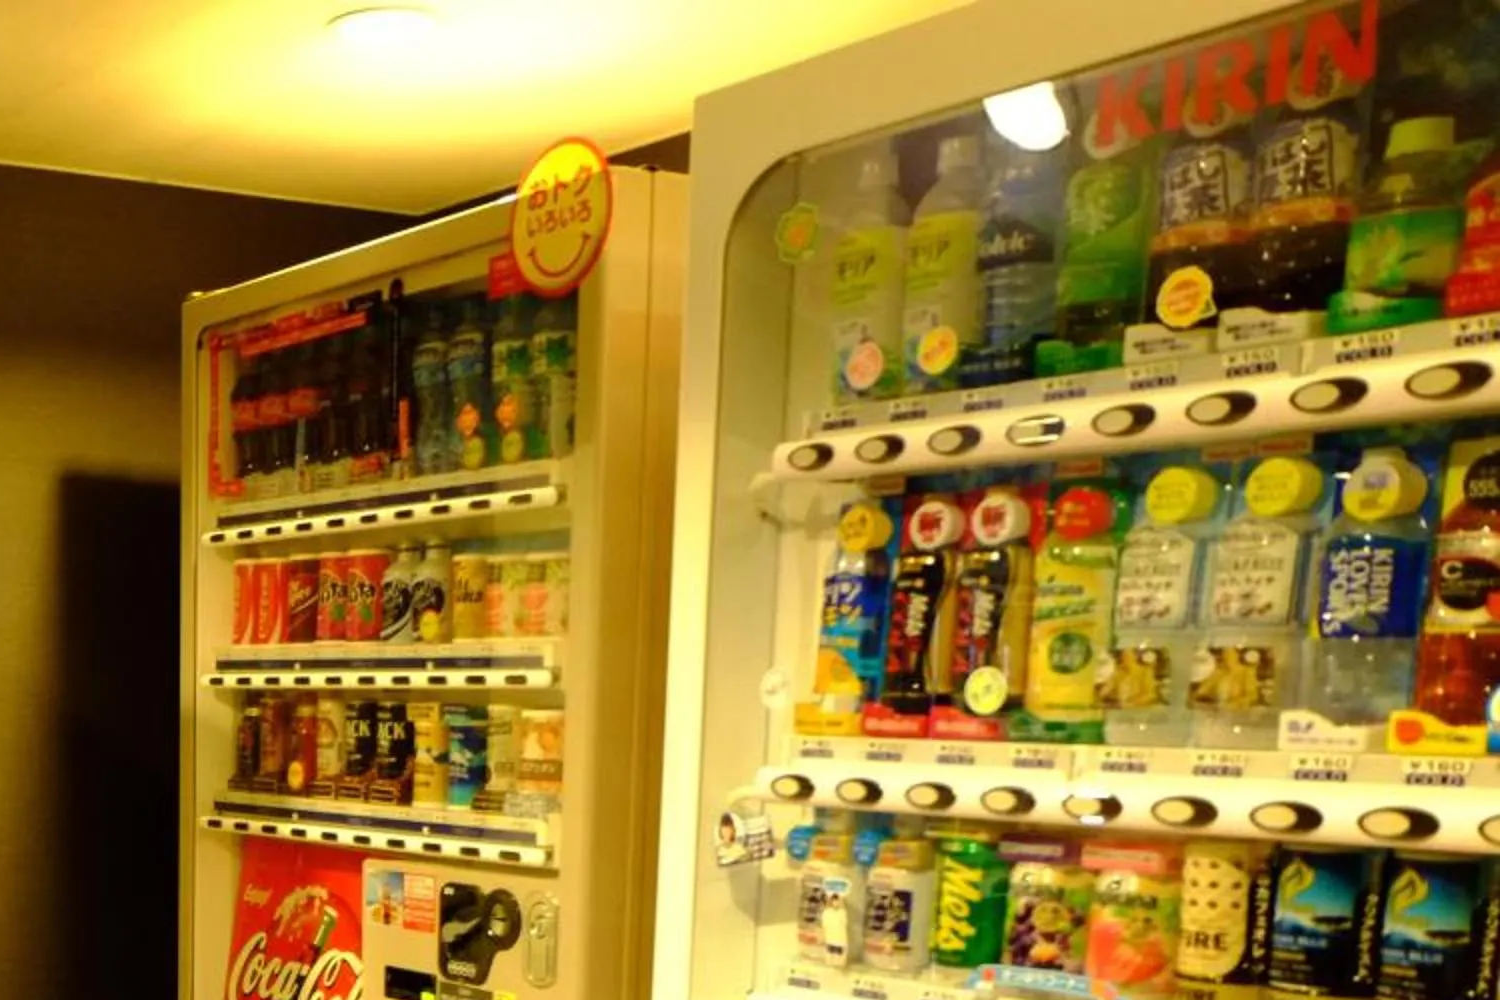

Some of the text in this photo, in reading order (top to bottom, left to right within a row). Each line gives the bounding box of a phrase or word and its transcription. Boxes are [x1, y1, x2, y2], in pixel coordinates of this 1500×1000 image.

[1094, 0, 1380, 150] KIRIN
[1370, 548, 1395, 614] KIRIN
[935, 856, 985, 950] Mets
